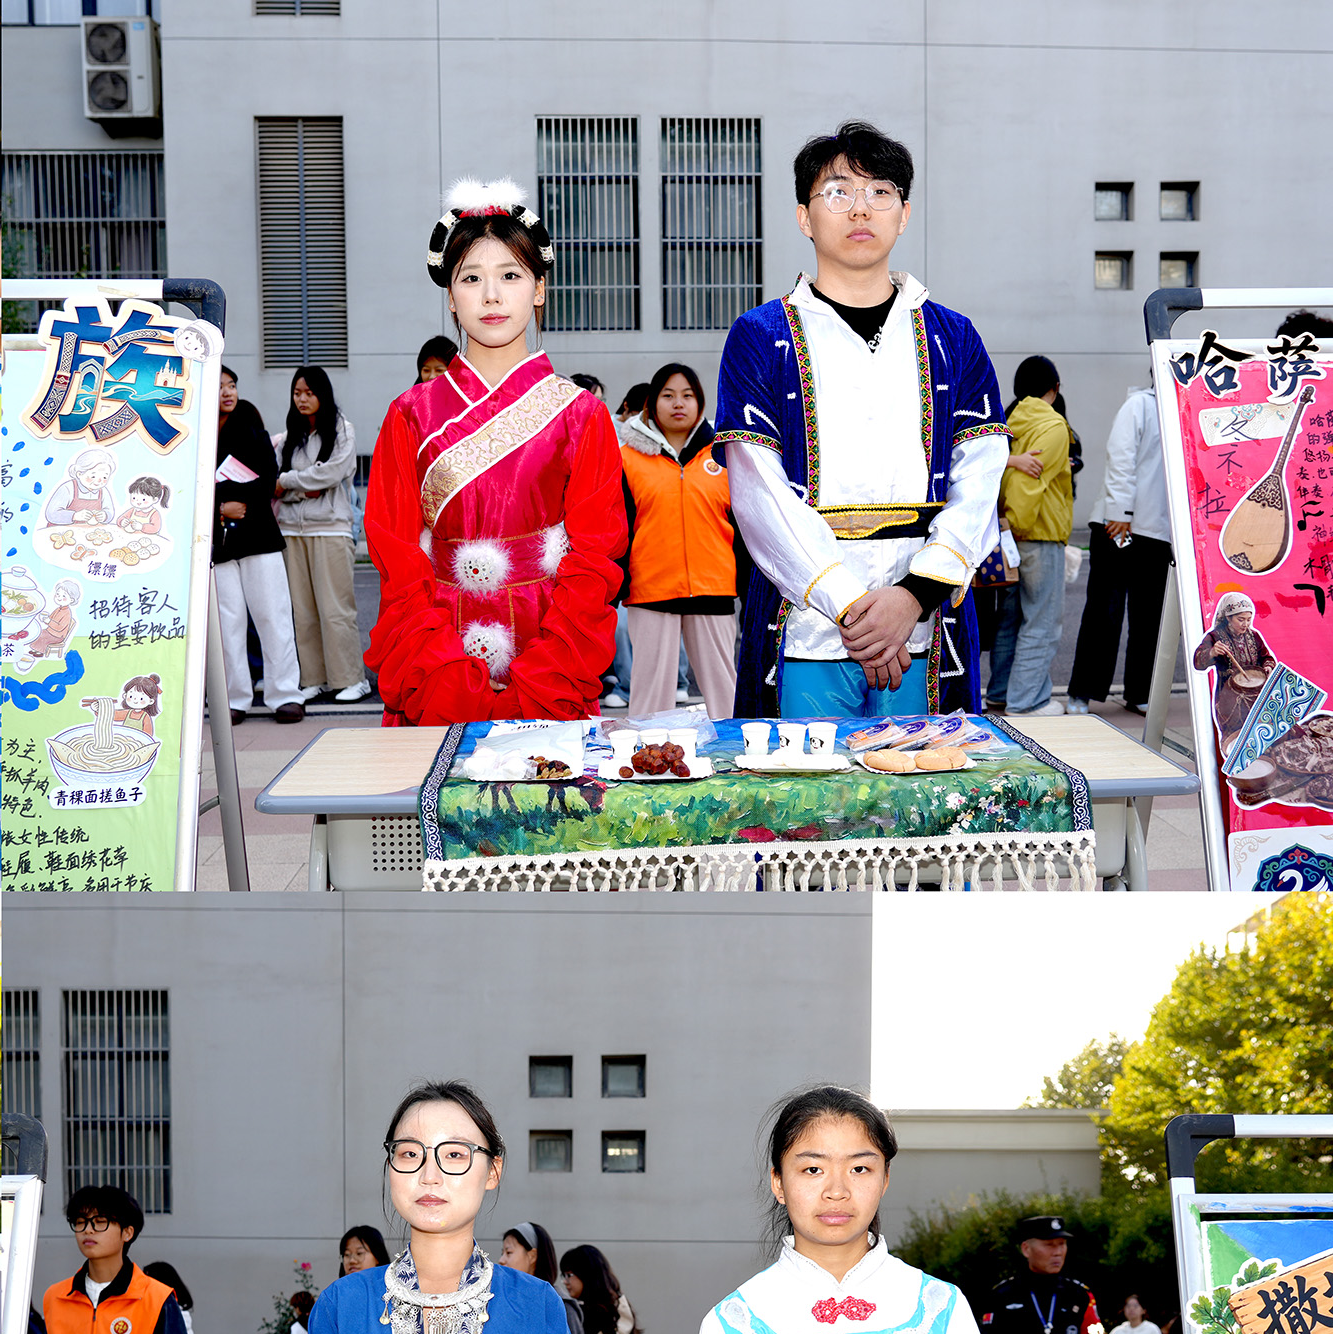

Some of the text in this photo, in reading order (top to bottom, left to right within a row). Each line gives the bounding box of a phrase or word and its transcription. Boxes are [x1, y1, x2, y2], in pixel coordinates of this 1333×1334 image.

[23, 305, 188, 449] 族
[1171, 332, 1321, 397] 哈萨
[89, 587, 178, 620] 招待客人
[89, 617, 185, 650] 的重要饮品
[53, 787, 144, 806] 青稞面搓鱼子
